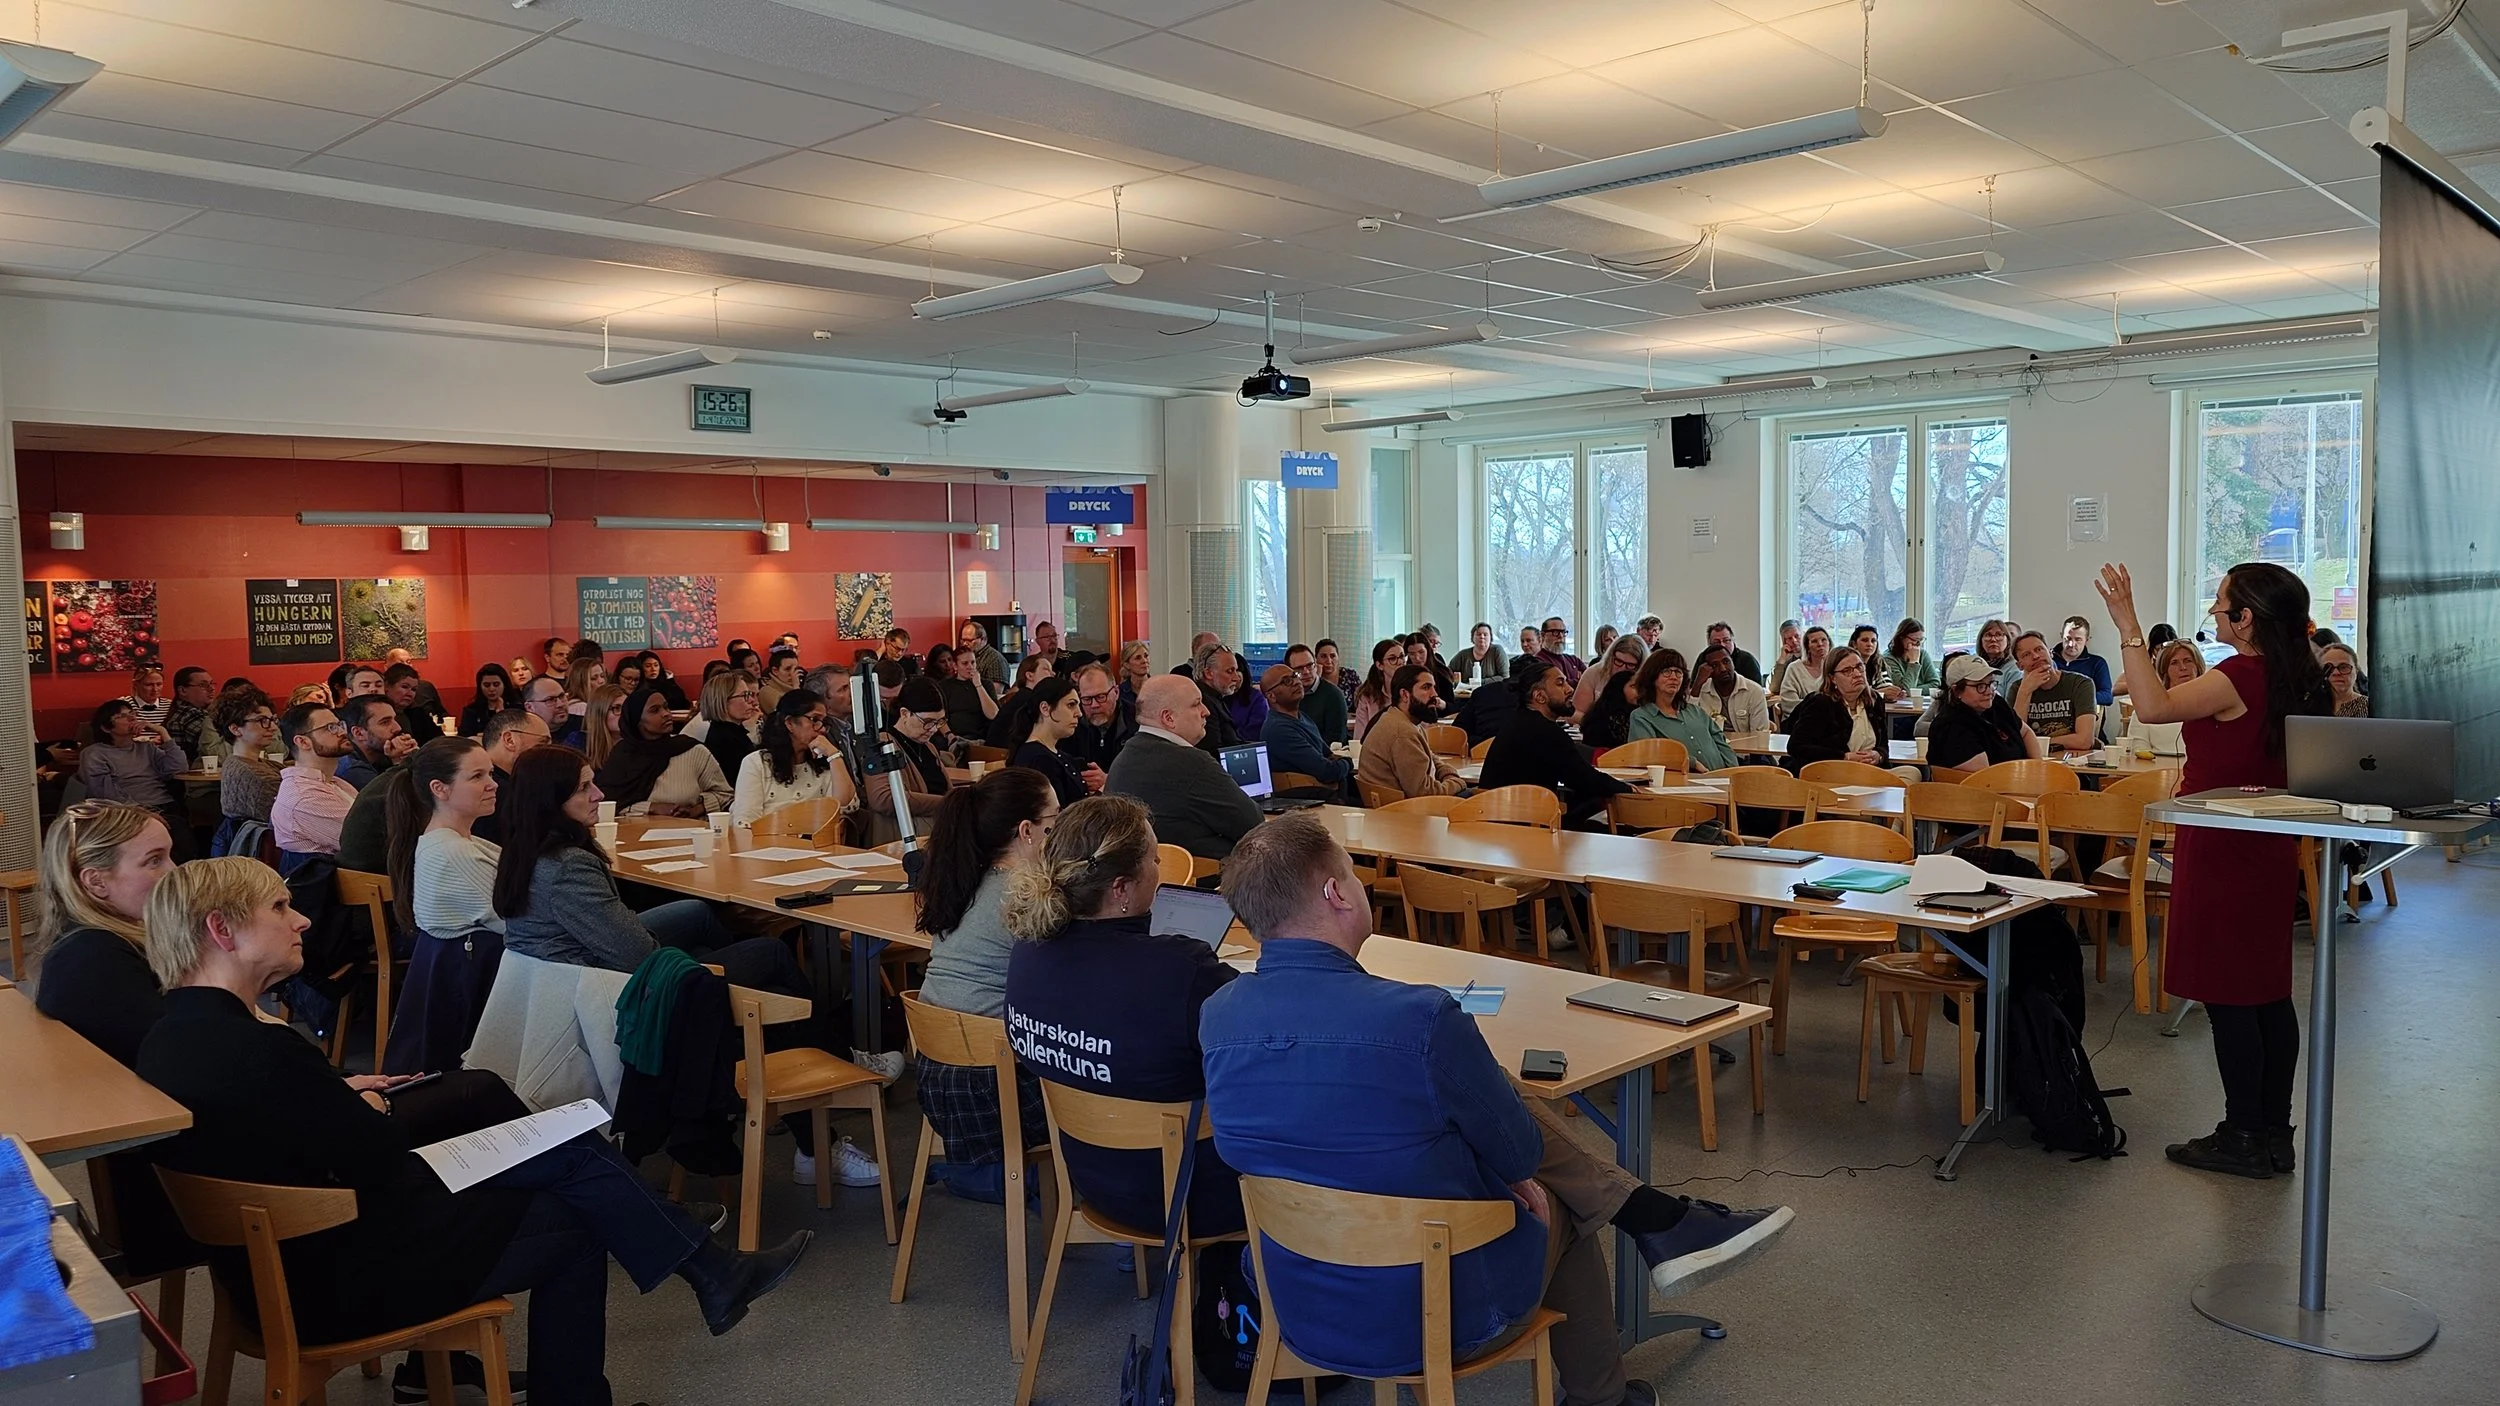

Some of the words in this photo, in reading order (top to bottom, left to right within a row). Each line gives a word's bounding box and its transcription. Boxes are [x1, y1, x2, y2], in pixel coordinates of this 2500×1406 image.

[1296, 466, 1324, 476] DRYCK
[1068, 501, 1111, 511] DRYCK
[254, 594, 281, 604] VISSA
[284, 594, 314, 604] TYCKER
[316, 593, 331, 603] ATT
[583, 589, 624, 599] OTROLIGT
[626, 589, 644, 599] NOG
[254, 605, 332, 621] HUNGERN
[584, 600, 597, 614] ÄR
[600, 601, 644, 614] TOMATEN
[265, 624, 279, 632] DEN
[280, 623, 301, 632] BÄSTA
[584, 614, 619, 629] SLÄKT
[624, 615, 645, 628] MED
[256, 632, 291, 646] HÅLLER
[294, 634, 307, 645] DU
[309, 633, 333, 645] MED?
[585, 629, 645, 644] POTATISEN
[1008, 1003, 1112, 1055] Naturskolan
[1009, 1023, 1112, 1083] Sollentuna
